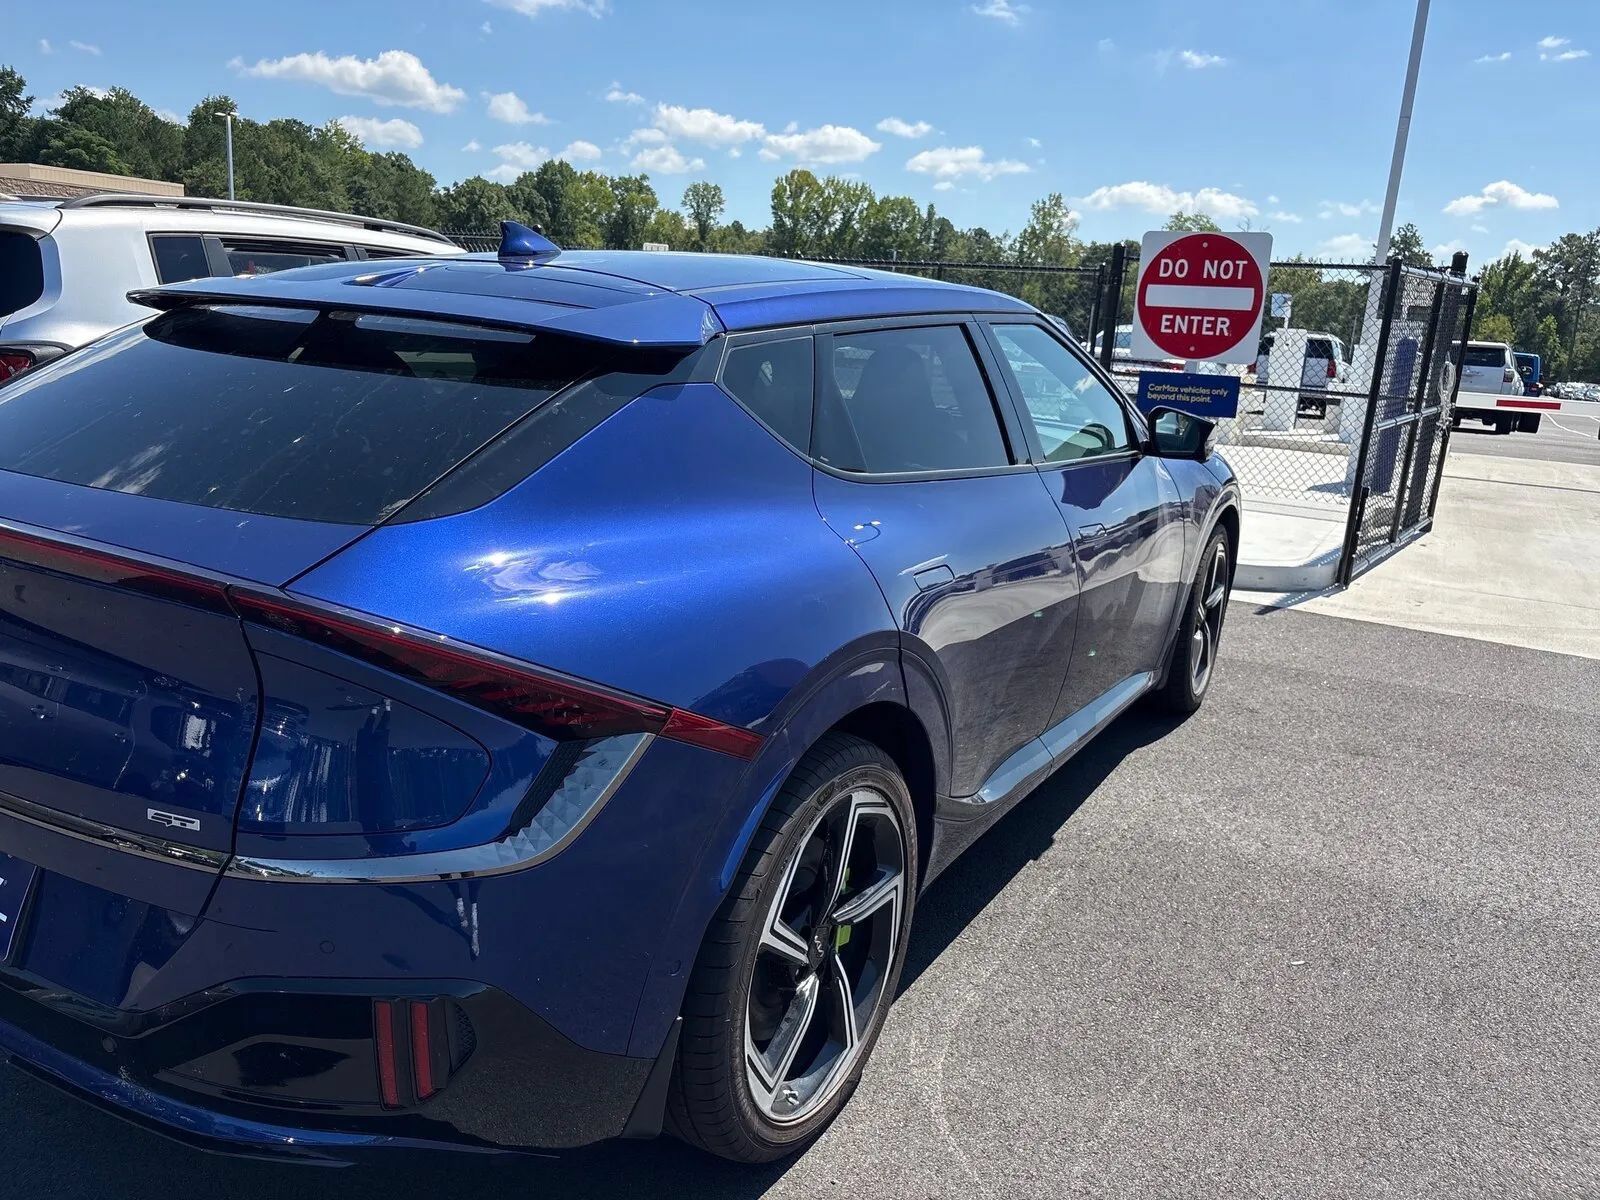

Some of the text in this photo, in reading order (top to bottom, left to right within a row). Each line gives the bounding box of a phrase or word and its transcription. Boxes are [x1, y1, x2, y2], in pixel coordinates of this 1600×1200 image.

[1159, 258, 1248, 280] DO NOT
[1160, 314, 1230, 337] ENTER
[1147, 392, 1212, 403] beyond this point.
[1148, 383, 1228, 397] CarMax vehicles only
